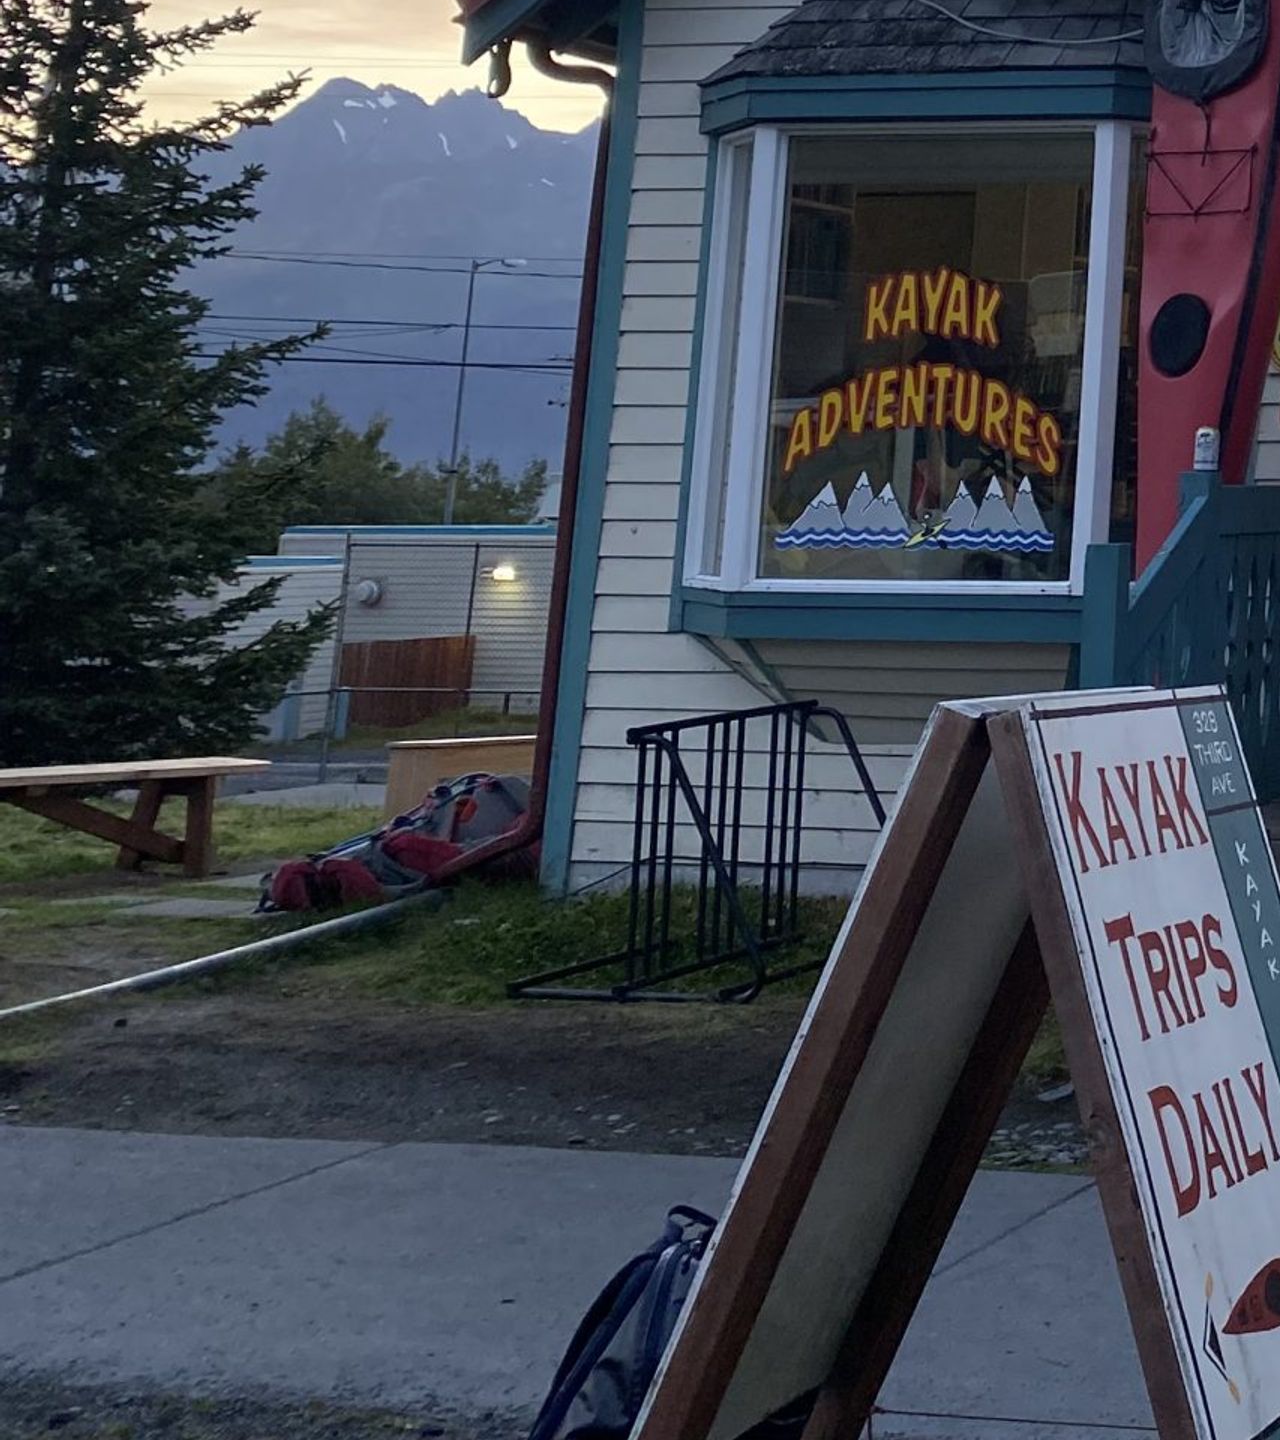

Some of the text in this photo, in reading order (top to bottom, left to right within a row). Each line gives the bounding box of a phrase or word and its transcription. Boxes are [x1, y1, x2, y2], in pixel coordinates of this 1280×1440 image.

[866, 266, 1003, 347] KAYAK
[783, 362, 1063, 477] ADVENTURES
[1192, 709, 1219, 734] 328
[1193, 740, 1233, 767] THIRD
[1053, 750, 1211, 873] KAYAK
[1211, 771, 1237, 797] AVE
[1235, 840, 1280, 981] KAYAK
[1104, 911, 1238, 1042] TRIPS
